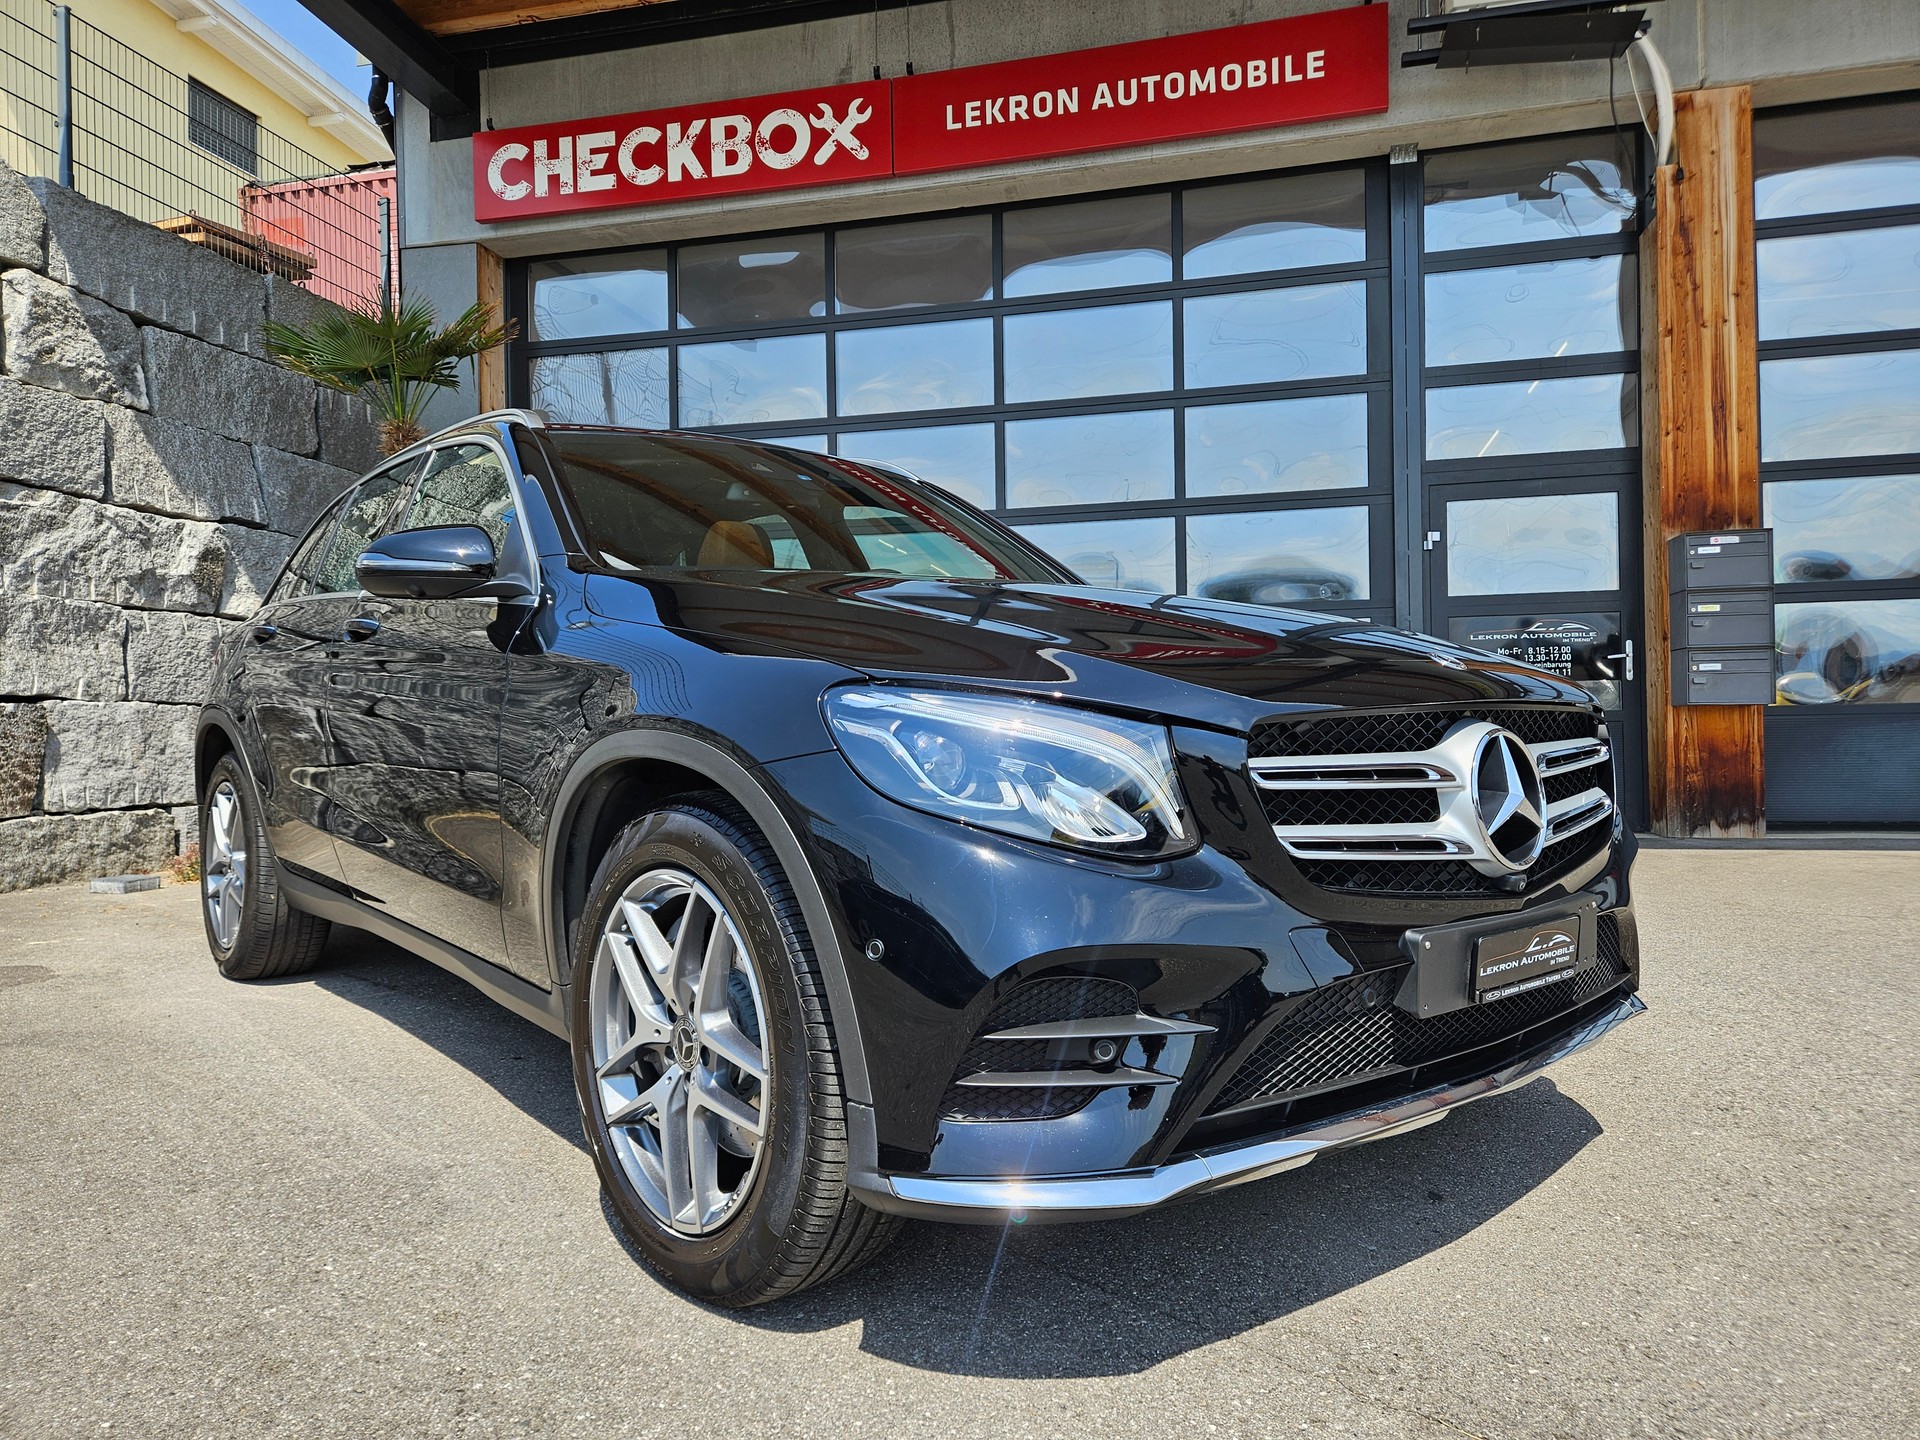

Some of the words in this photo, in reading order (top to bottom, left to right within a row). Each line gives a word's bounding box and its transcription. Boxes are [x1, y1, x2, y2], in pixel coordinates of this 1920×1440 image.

[946, 86, 1079, 131] LEKRON
[1091, 50, 1326, 111] AUTOMOBILE
[487, 98, 872, 201] CHECKBOX
[1470, 633, 1518, 641] LEKRON
[1520, 631, 1597, 639] AUTOMOBILE
[1497, 648, 1522, 657] Mo-Fr
[1528, 646, 1571, 654] 8.15-12.00
[1524, 653, 1572, 662] 13.30-17.00
[711, 852, 796, 1056] SCORPION
[1480, 960, 1519, 977] LEKRON
[1520, 945, 1575, 966] AUTOMOBILE
